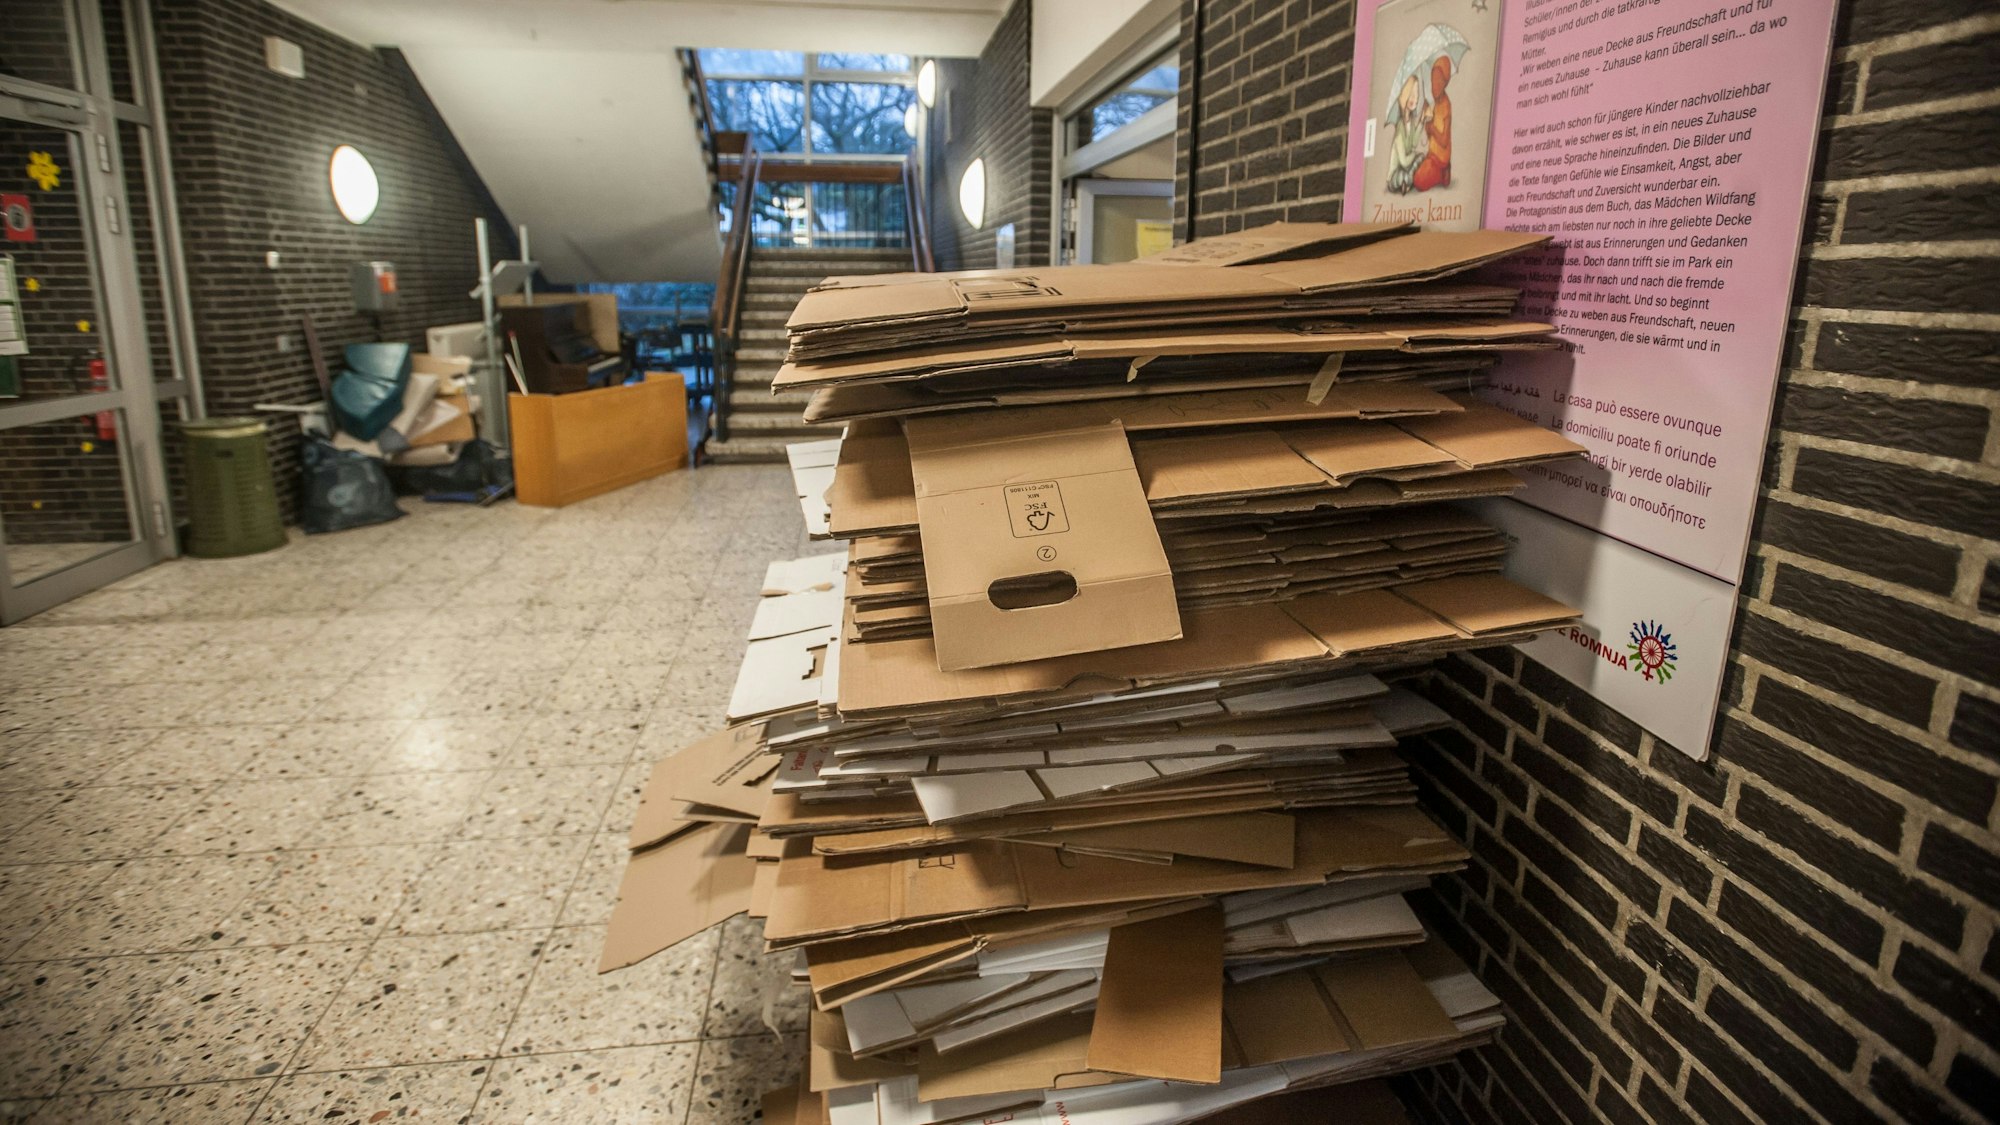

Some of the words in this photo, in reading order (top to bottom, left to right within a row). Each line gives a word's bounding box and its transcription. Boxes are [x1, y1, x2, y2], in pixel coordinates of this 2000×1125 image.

[1522, 26, 1556, 44] Remigius
[1558, 21, 1573, 32] und
[1576, 11, 1600, 28] durch
[1602, 7, 1615, 19] die
[1524, 2, 1578, 27] Schüler/innen
[1536, 58, 1561, 72] weben
[1562, 53, 1580, 64] eine
[1582, 46, 1604, 59] neue
[1606, 36, 1634, 52] Decke
[1636, 31, 1654, 44] aus
[1656, 8, 1727, 38] Freundschaft
[1730, 2, 1752, 18] und
[1518, 82, 1529, 92] ein
[1530, 78, 1554, 90] neues
[1555, 66, 1590, 84] Zuhause
[1602, 54, 1642, 72] Zuhause
[1644, 47, 1668, 62] kann
[1672, 34, 1709, 54] überall
[1712, 28, 1746, 44] sein...
[1750, 21, 1765, 34] da
[1770, 16, 1788, 29] wo
[1521, 47, 1546, 61] Mütter.
[1514, 128, 1528, 138] Hier
[1530, 124, 1545, 136] wird
[1546, 120, 1566, 132] auch
[1567, 116, 1592, 130] schon
[1594, 112, 1606, 124] für
[1606, 108, 1643, 124] jüngere
[1645, 100, 1678, 115] Kinder
[1680, 82, 1772, 108] nachvollziehbar
[1516, 98, 1532, 110] man
[1534, 94, 1549, 106] sich
[1551, 89, 1569, 102] wohl
[1512, 144, 1534, 155] davon
[1534, 139, 1562, 152] erzählt,
[1565, 136, 1578, 146] wie
[1580, 131, 1610, 144] schwer
[1612, 130, 1622, 140] es
[1625, 126, 1638, 138] ist,
[1642, 123, 1650, 134] in
[1652, 120, 1668, 132] ein
[1670, 116, 1704, 130] neues
[1706, 107, 1757, 125] Zuhause
[1510, 160, 1524, 172] und
[1526, 158, 1541, 170] eine
[1543, 156, 1562, 168] neue
[1564, 150, 1598, 166] Sprache
[1599, 142, 1670, 160] hineinzufinden.
[1673, 137, 1690, 150] Die
[1693, 132, 1726, 148] Bilder
[1728, 128, 1752, 142] und
[1508, 177, 1520, 188] die
[1522, 175, 1540, 186] Texte
[1542, 173, 1568, 185] fangen
[1570, 168, 1602, 181] Gefühle
[1604, 166, 1618, 177] wie
[1621, 158, 1676, 176] Einsamkeit,
[1679, 156, 1712, 170] Angst,
[1715, 152, 1742, 166] aber
[1507, 192, 1525, 204] auch
[1526, 188, 1576, 202] Freundschaft
[1578, 187, 1594, 198] und
[1595, 182, 1642, 197] Zuversicht
[1644, 178, 1698, 192] wunderbar
[1700, 176, 1720, 188] ein.
[1372, 204, 1424, 224] Zuhause
[1428, 198, 1462, 222] kann
[1506, 208, 1518, 218] Die
[1519, 204, 1567, 218] Protagonistin
[1568, 204, 1584, 214] aus
[1586, 202, 1604, 213] dem
[1606, 200, 1632, 212] Buch,
[1634, 199, 1652, 210] das
[1654, 196, 1702, 208] Mädchen
[1706, 192, 1756, 206] Wildfang
[1504, 222, 1530, 232] möchte
[1532, 222, 1546, 232] sich
[1548, 223, 1560, 232] am
[1562, 220, 1594, 231] liebsten
[1596, 220, 1610, 230] nur
[1613, 218, 1634, 230] noch
[1638, 218, 1646, 228] in
[1648, 217, 1668, 228] ihre
[1670, 215, 1712, 230] geliebte
[1716, 213, 1752, 226] Decke
[1574, 238, 1584, 248] ist
[1586, 240, 1601, 248] aus
[1604, 237, 1664, 250] Erinnerungen
[1668, 236, 1688, 248] und
[1690, 236, 1748, 248] Gedanken
[1584, 256, 1604, 266] Doch
[1607, 256, 1630, 266] dann
[1632, 256, 1652, 268] trifft
[1654, 256, 1670, 268] sie
[1672, 256, 1684, 268] im
[1688, 256, 1712, 268] Park
[1716, 257, 1733, 268] ein
[1567, 274, 1582, 284] das
[1584, 274, 1594, 284] ihr
[1597, 274, 1618, 285] nach
[1620, 275, 1638, 286] und
[1641, 276, 1664, 287] nach
[1667, 276, 1682, 288] die
[1686, 276, 1724, 289] fremde
[1562, 291, 1576, 300] und
[1578, 292, 1592, 302] mit
[1594, 293, 1604, 302] ihr
[1608, 294, 1631, 304] lacht.
[1634, 294, 1654, 306] Und
[1656, 297, 1668, 307] so
[1670, 296, 1710, 310] beginnt
[1544, 306, 1568, 318] Decke
[1570, 310, 1578, 318] zu
[1582, 310, 1608, 321] weben
[1611, 313, 1626, 322] aus
[1630, 312, 1696, 330] Freundschaft,
[1700, 320, 1735, 332] neuen
[1560, 324, 1618, 341] Erinnerungen,
[1620, 331, 1634, 342] die
[1636, 332, 1650, 344] sie
[1653, 334, 1684, 348] wärmt
[1687, 340, 1708, 351] und
[1710, 340, 1720, 352] in
[1554, 390, 1566, 403] La
[1568, 394, 1592, 409] casa
[1595, 400, 1617, 414] può
[1620, 406, 1660, 424] essere
[1663, 414, 1722, 438] ovunque
[1552, 415, 1563, 429] La
[1566, 419, 1614, 442] domiciliu
[1616, 434, 1650, 452] poate
[1654, 440, 1662, 454] fi
[1665, 445, 1717, 468] oriunde
[1612, 456, 1626, 472] bir
[1629, 464, 1662, 483] yerde
[1666, 474, 1712, 498] olabilir
[1024, 502, 1048, 510] FSC
[1549, 470, 1584, 488] μπορεί
[1586, 481, 1598, 494] να
[1600, 484, 1626, 503] είναι
[1630, 496, 1706, 530] οπουδήποτε
[1042, 548, 1051, 558] 2
[1570, 628, 1628, 670] ROMNJA
